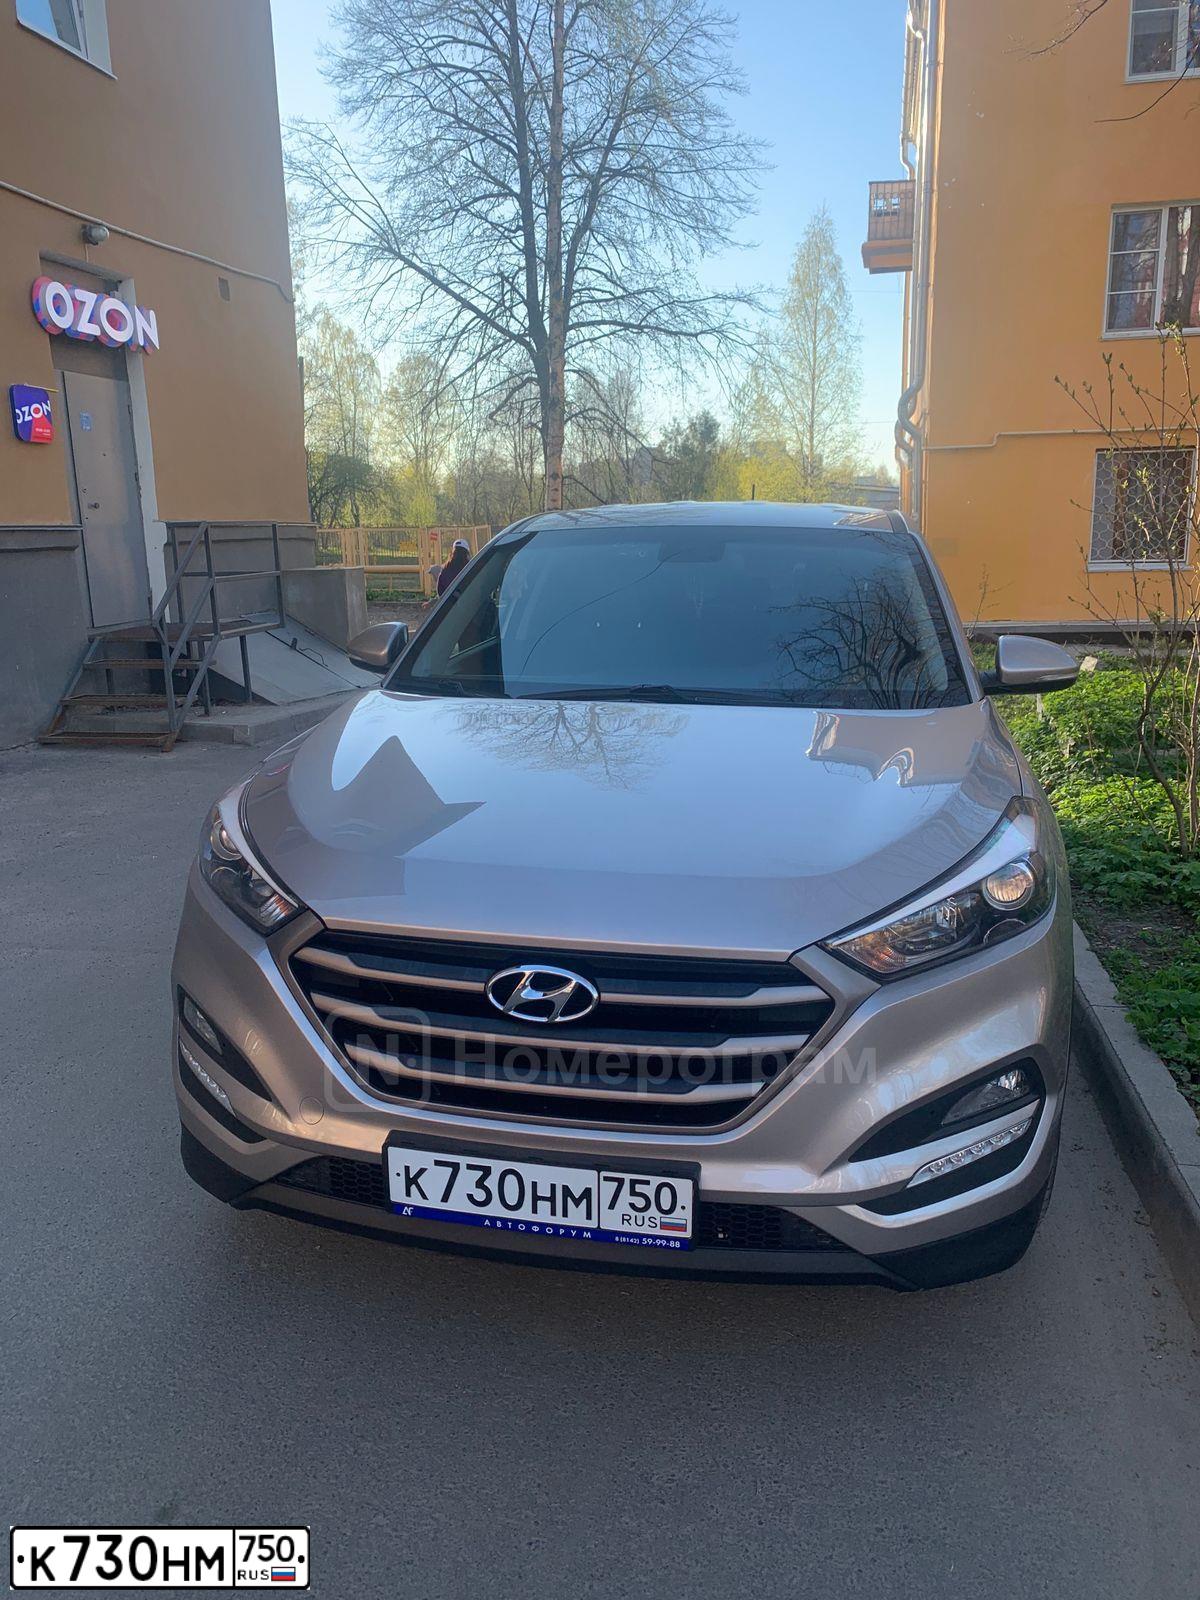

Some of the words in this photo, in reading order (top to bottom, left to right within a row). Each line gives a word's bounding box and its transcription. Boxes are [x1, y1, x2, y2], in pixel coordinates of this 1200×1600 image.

[44, 281, 160, 350] OZON
[403, 1158, 593, 1221] К730НМ
[602, 1175, 678, 1215] 750
[483, 1219, 592, 1239] АВТОФОРУМ
[621, 1213, 658, 1229] RUS
[642, 1237, 681, 1248] 59-99-88
